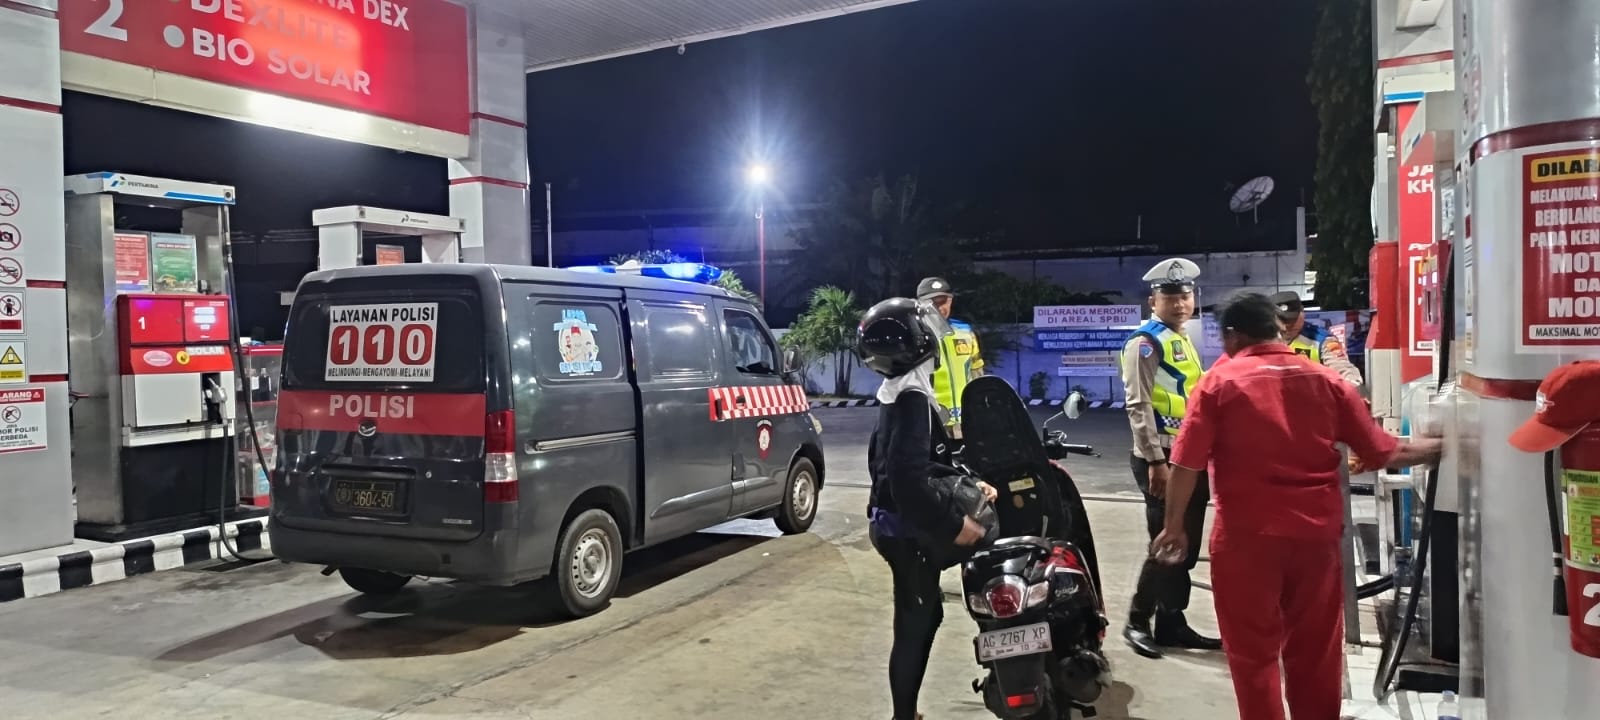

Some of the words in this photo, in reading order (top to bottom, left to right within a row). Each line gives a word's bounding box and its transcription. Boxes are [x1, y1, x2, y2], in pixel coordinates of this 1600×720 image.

[83, 0, 128, 42] 2
[362, 0, 410, 31] DEX
[192, 27, 255, 66] BIO
[267, 47, 371, 96] SOLAR
[1537, 159, 1600, 177] DILAR
[1530, 185, 1598, 204] MELAKUKAN
[1530, 230, 1567, 248] PADA
[332, 308, 388, 323] LAYANAN
[392, 307, 435, 321] POLISI
[1037, 307, 1086, 316] DILARANG
[1089, 306, 1137, 315] MEROKOK
[1047, 316, 1058, 324] DI
[1099, 315, 1128, 323] SPBU
[138, 316, 146, 330] 1
[1535, 327, 1581, 337] MAKSIMAL
[338, 328, 426, 361] 110
[329, 394, 414, 419] POLISI
[1000, 630, 1025, 645] 2767
[1032, 627, 1046, 640] XP
